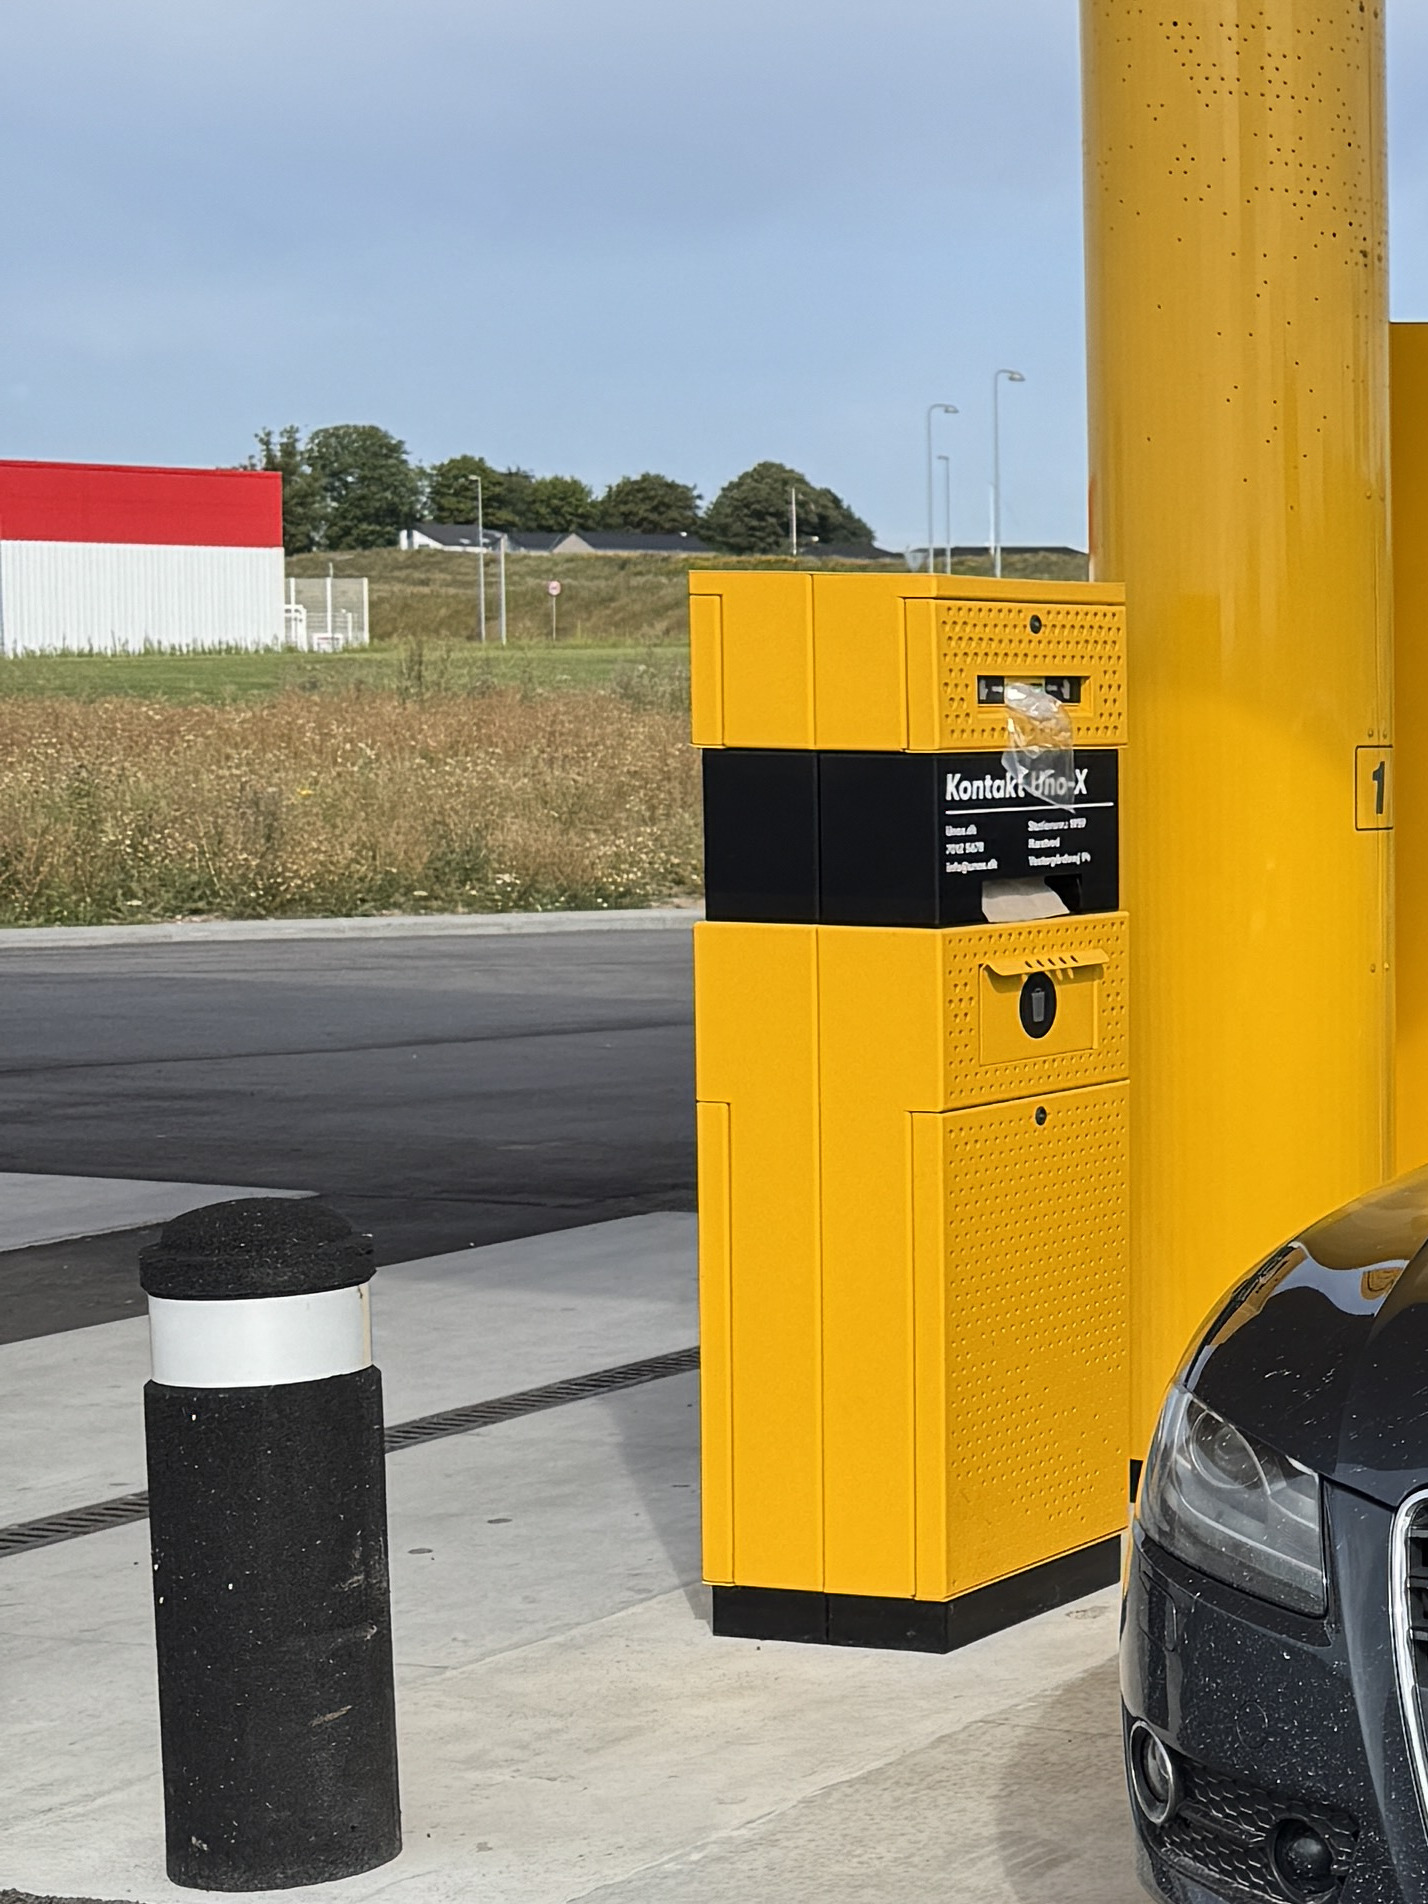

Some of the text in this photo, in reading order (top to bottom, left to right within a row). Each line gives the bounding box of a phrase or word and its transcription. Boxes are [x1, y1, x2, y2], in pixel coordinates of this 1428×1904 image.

[945, 768, 1089, 801] Kontakt Uno-X
[1372, 760, 1386, 815] 1
